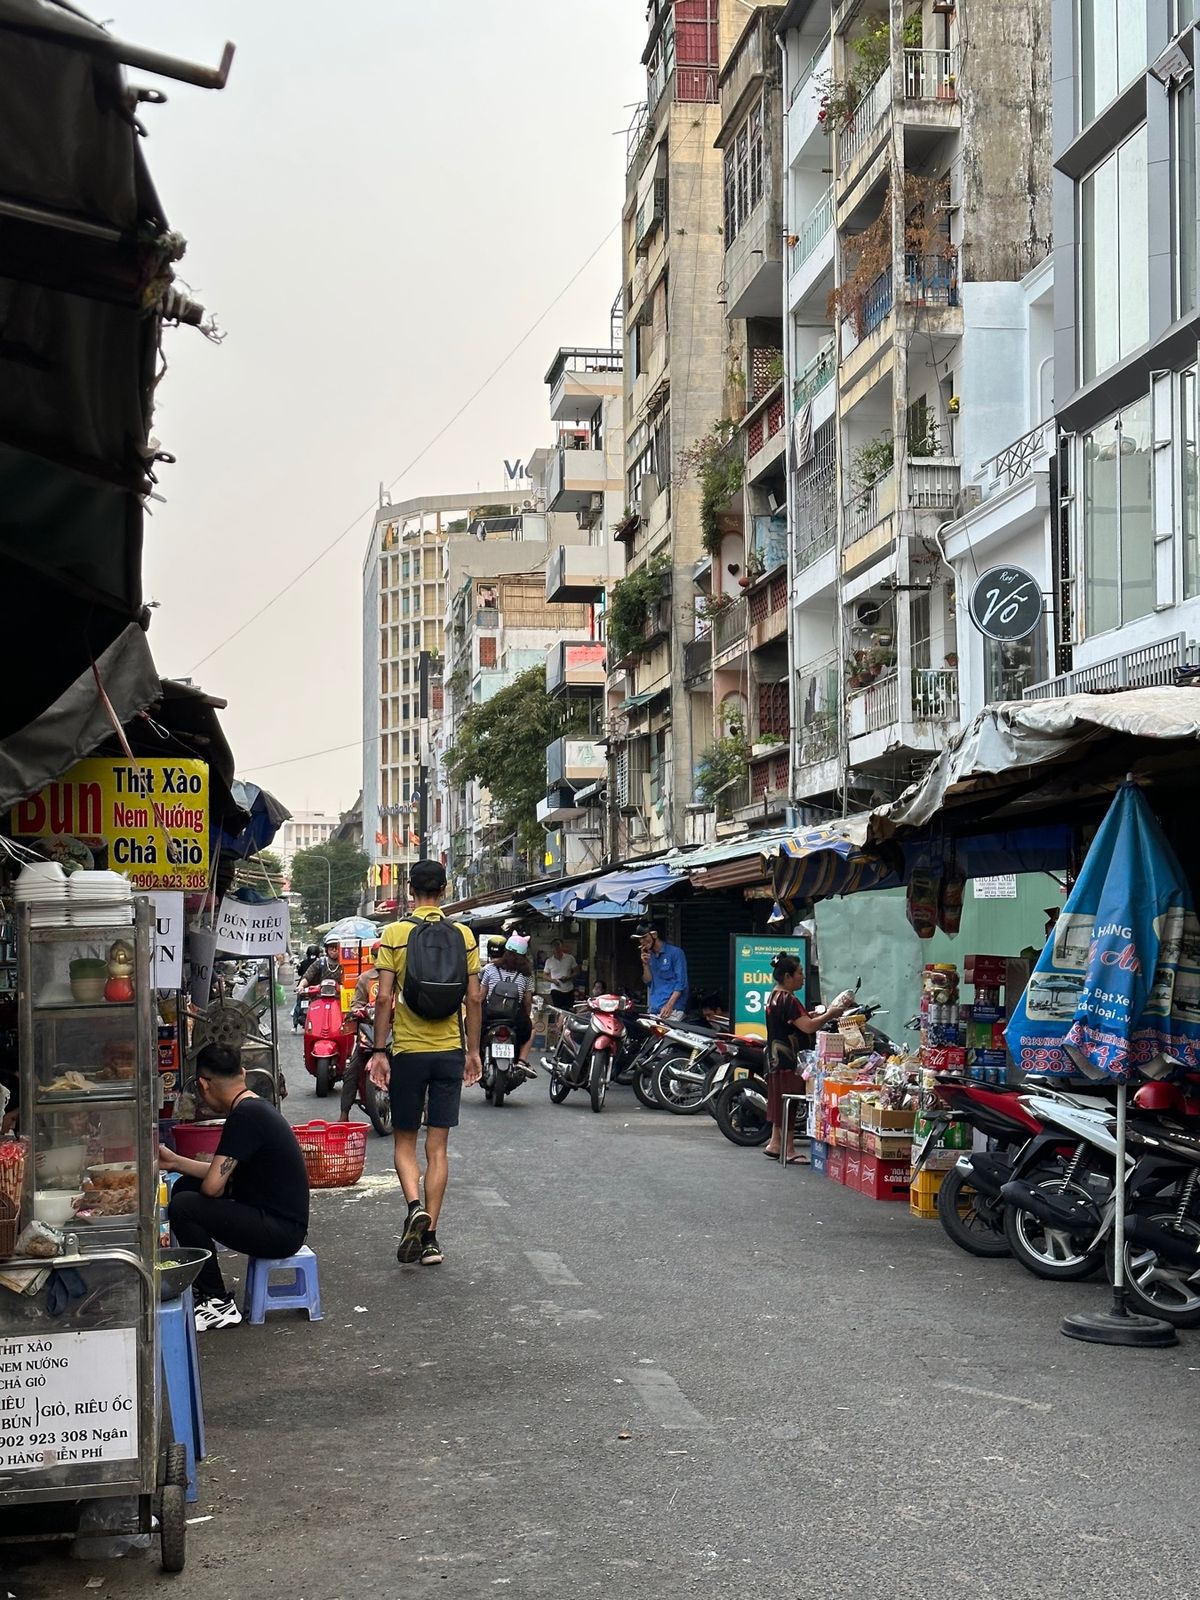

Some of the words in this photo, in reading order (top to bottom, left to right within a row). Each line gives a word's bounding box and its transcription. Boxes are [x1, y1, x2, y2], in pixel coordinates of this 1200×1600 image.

[112, 767, 155, 799] Thịt
[161, 767, 202, 794] Xào
[114, 802, 148, 828] Nem
[153, 800, 204, 833] Nướng
[114, 835, 157, 864] Chả
[223, 912, 248, 927] BÚN
[252, 915, 283, 929] RIÊU
[218, 927, 254, 943] CANH
[258, 928, 284, 942] BÚN
[743, 970, 773, 984] BÚN
[1094, 987, 1113, 1004] Bạt
[1077, 1000, 1093, 1012] các
[1095, 1004, 1116, 1020] loại
[27, 1339, 53, 1353] XÀO
[26, 1356, 69, 1371] NƯỚNG
[25, 1374, 47, 1388] GIÒ
[0, 1395, 25, 1411] IÊU
[41, 1401, 70, 1417] GIÒ,
[75, 1398, 108, 1415] RIÊU
[112, 1394, 133, 1411] ỐC
[1, 1414, 32, 1430] BÚN
[29, 1432, 56, 1446] 923
[60, 1430, 88, 1443] 308
[92, 1428, 128, 1442] Ngân
[7, 1451, 44, 1465] HÀNG
[56, 1446, 78, 1461] IỄN
[81, 1445, 103, 1459] PHÍ
